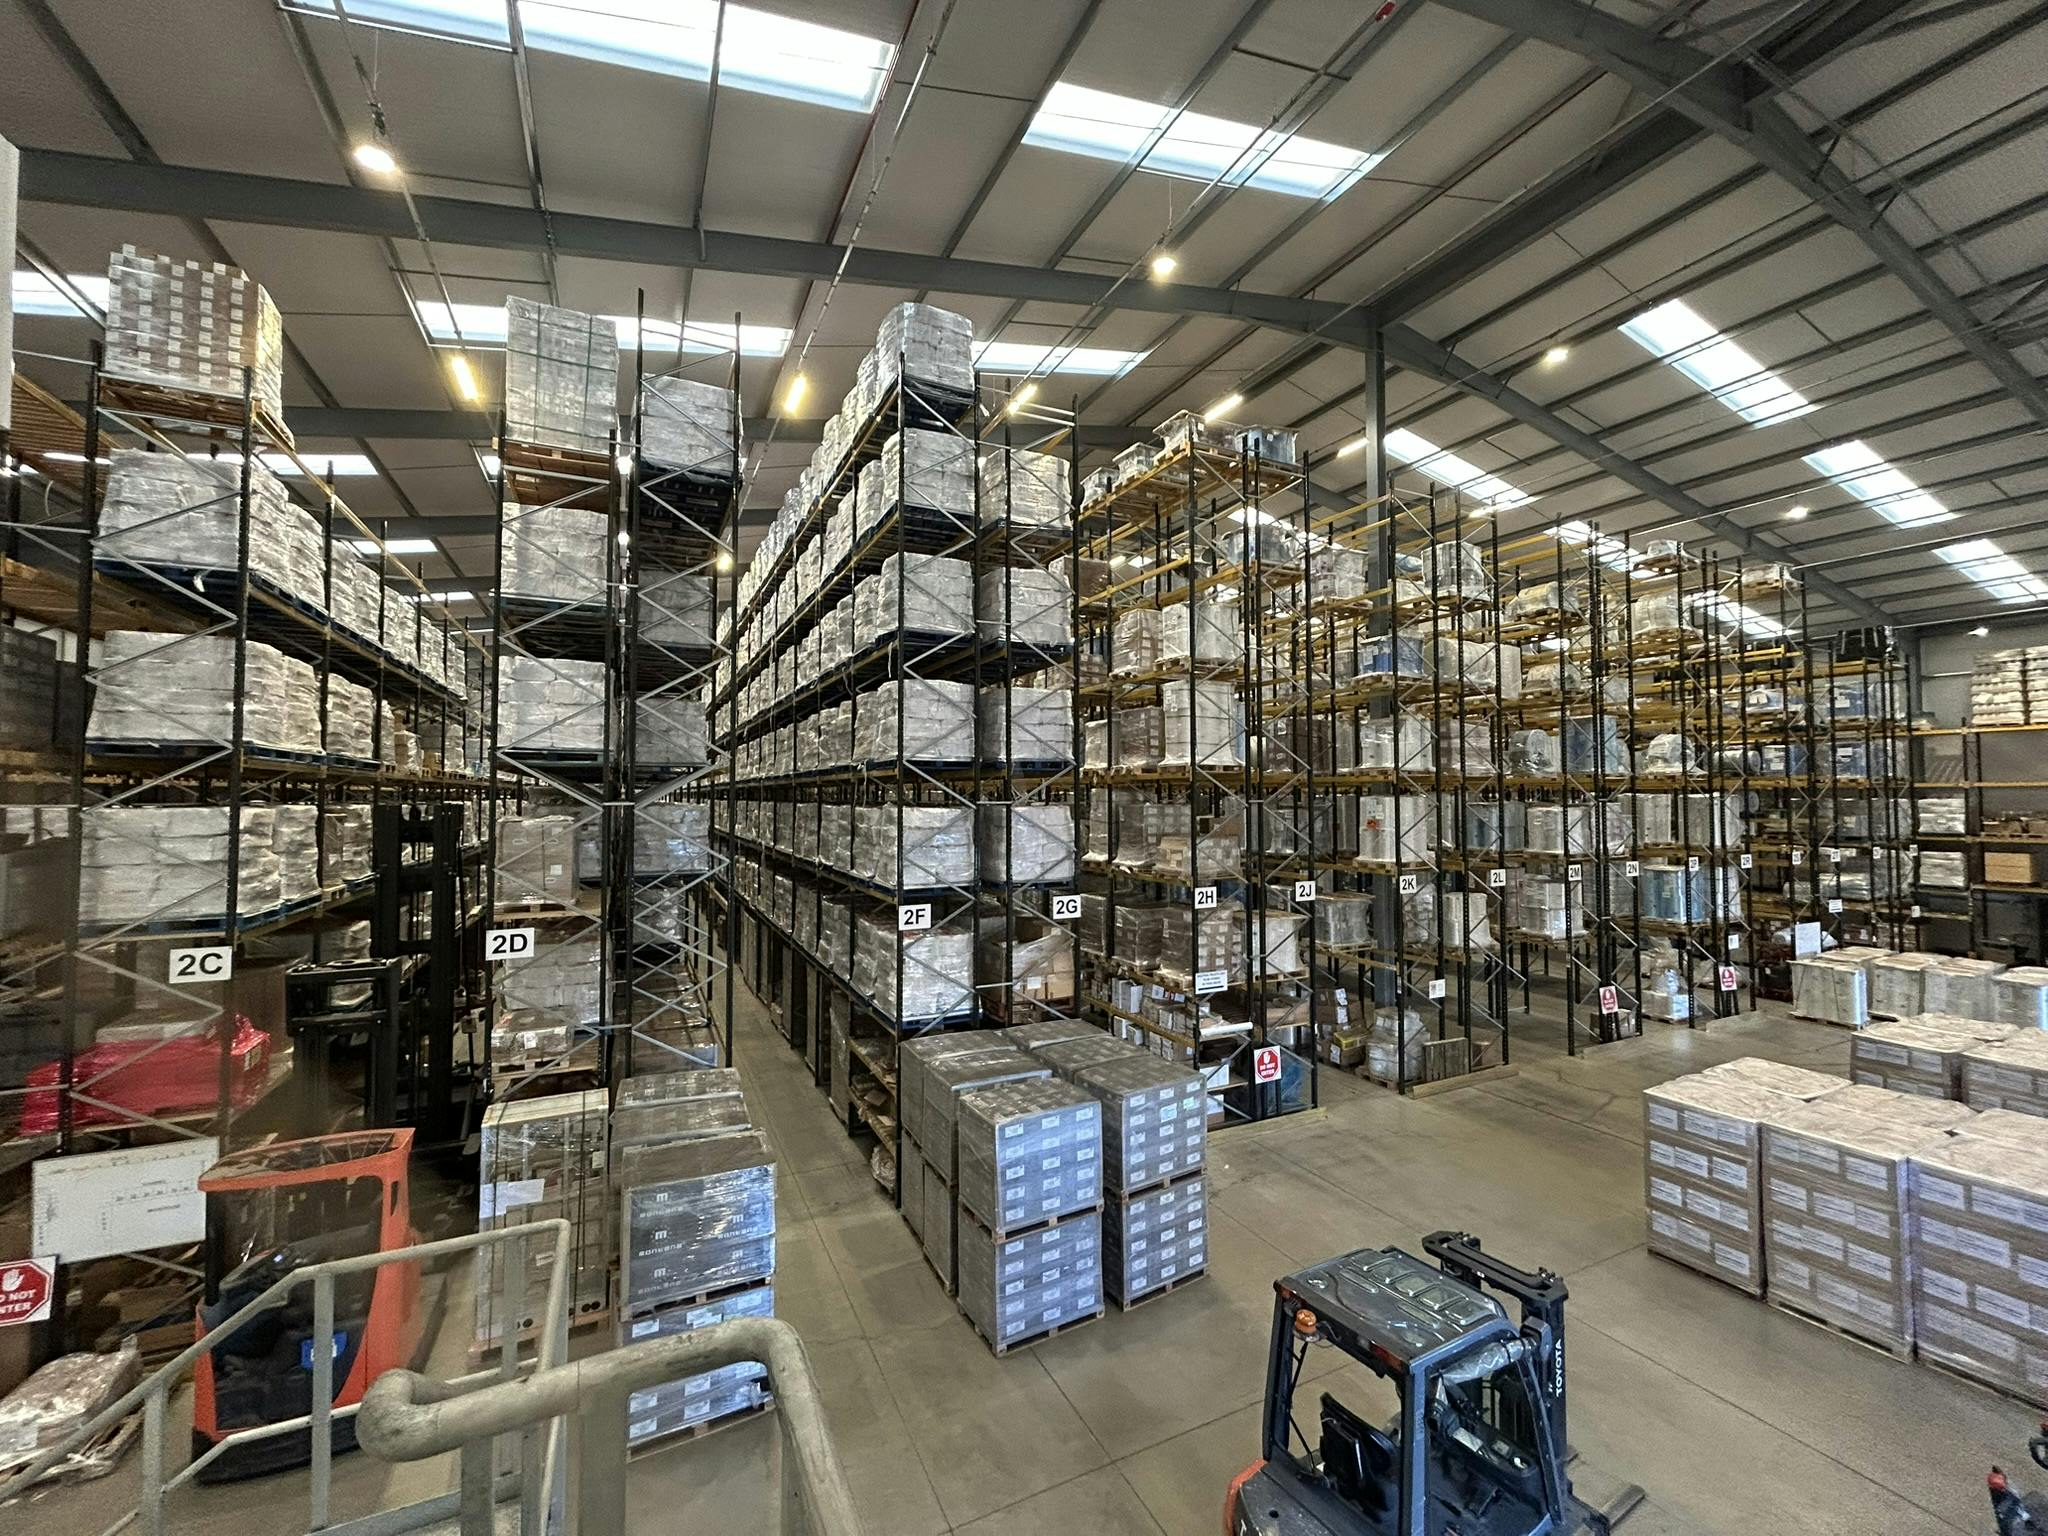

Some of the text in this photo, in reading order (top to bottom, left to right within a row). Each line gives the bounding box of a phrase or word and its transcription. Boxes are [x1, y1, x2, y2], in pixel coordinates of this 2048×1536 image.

[1570, 866, 1582, 878] 2M
[1628, 863, 1638, 874] 2N
[1493, 871, 1504, 883] 2L
[1299, 884, 1313, 898] 2J
[1402, 878, 1415, 891] 2K
[1197, 889, 1214, 905] 2H
[1056, 898, 1078, 915] 2G
[904, 908, 926, 926] 2F
[492, 933, 528, 954] 2D
[177, 952, 223, 977] 2C
[9, 1289, 36, 1301] NOT
[0, 1302, 31, 1314] NTER
